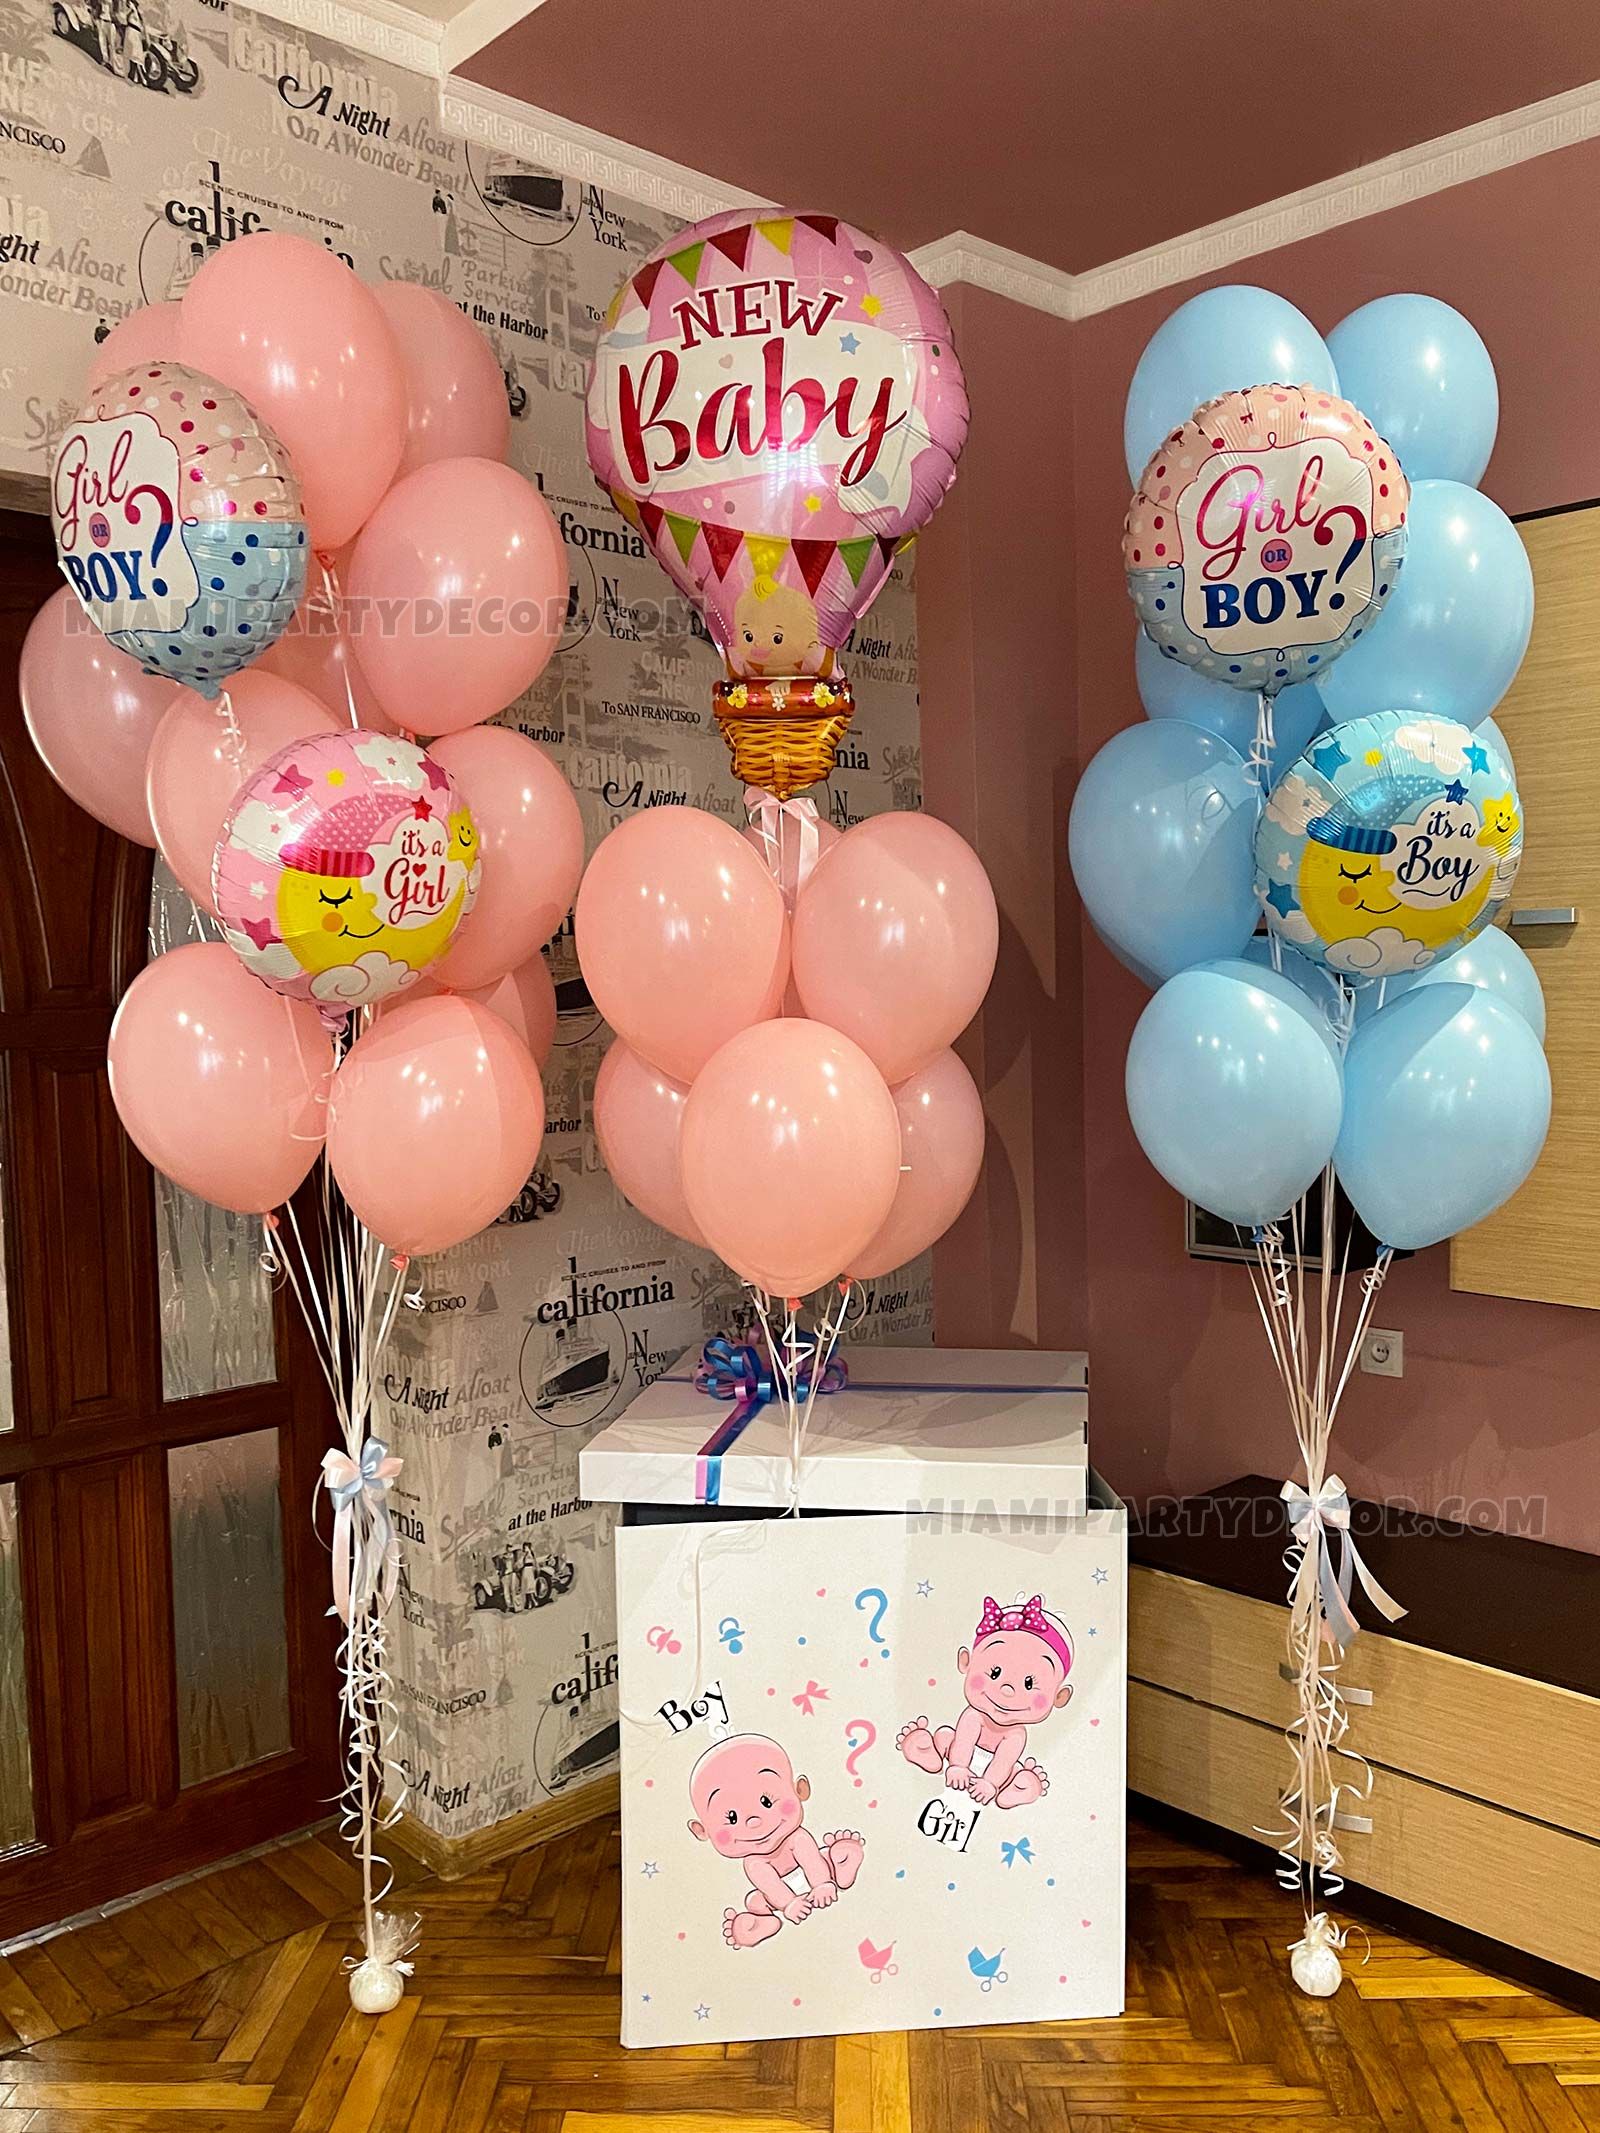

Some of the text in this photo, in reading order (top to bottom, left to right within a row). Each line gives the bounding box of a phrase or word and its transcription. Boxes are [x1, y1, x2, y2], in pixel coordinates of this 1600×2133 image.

[278, 75, 455, 163] A Night Afloat
[287, 115, 320, 146] On
[199, 178, 345, 230] SCENIC CRUISES TO AND FROM
[588, 184, 626, 228] New
[590, 217, 628, 252] York
[472, 304, 496, 325] the
[499, 311, 549, 340] Harbor
[672, 278, 843, 351] NEW
[617, 336, 907, 488] Baby
[54, 429, 133, 552] Girl
[91, 523, 109, 538] OR
[555, 511, 647, 559] fornia
[1195, 455, 1324, 581] Girl
[1264, 548, 1288, 564] OR
[601, 576, 640, 621] New
[605, 615, 642, 642] York
[856, 637, 892, 660] Night
[601, 700, 701, 725] To SAN FRANCISCO
[602, 780, 736, 814] A Night Afloat
[401, 829, 445, 857] it's a
[1426, 810, 1476, 839] it's a
[1396, 836, 1480, 902] Boy
[383, 857, 451, 925] Girl
[544, 1117, 582, 1134] arbor
[588, 1267, 619, 1278] CRUISES
[620, 1264, 630, 1272] TO
[631, 1261, 646, 1270] AND
[647, 1259, 667, 1268] FROM
[537, 1256, 676, 1324] california
[875, 1290, 909, 1315] Night
[631, 1328, 668, 1368] New
[384, 1374, 412, 1405] A
[411, 1386, 450, 1415] Night
[454, 1368, 511, 1406] Afloat
[508, 1514, 522, 1531] at
[526, 1508, 547, 1526] the
[653, 1680, 729, 1736] Boy
[917, 1799, 981, 1853] Girl
